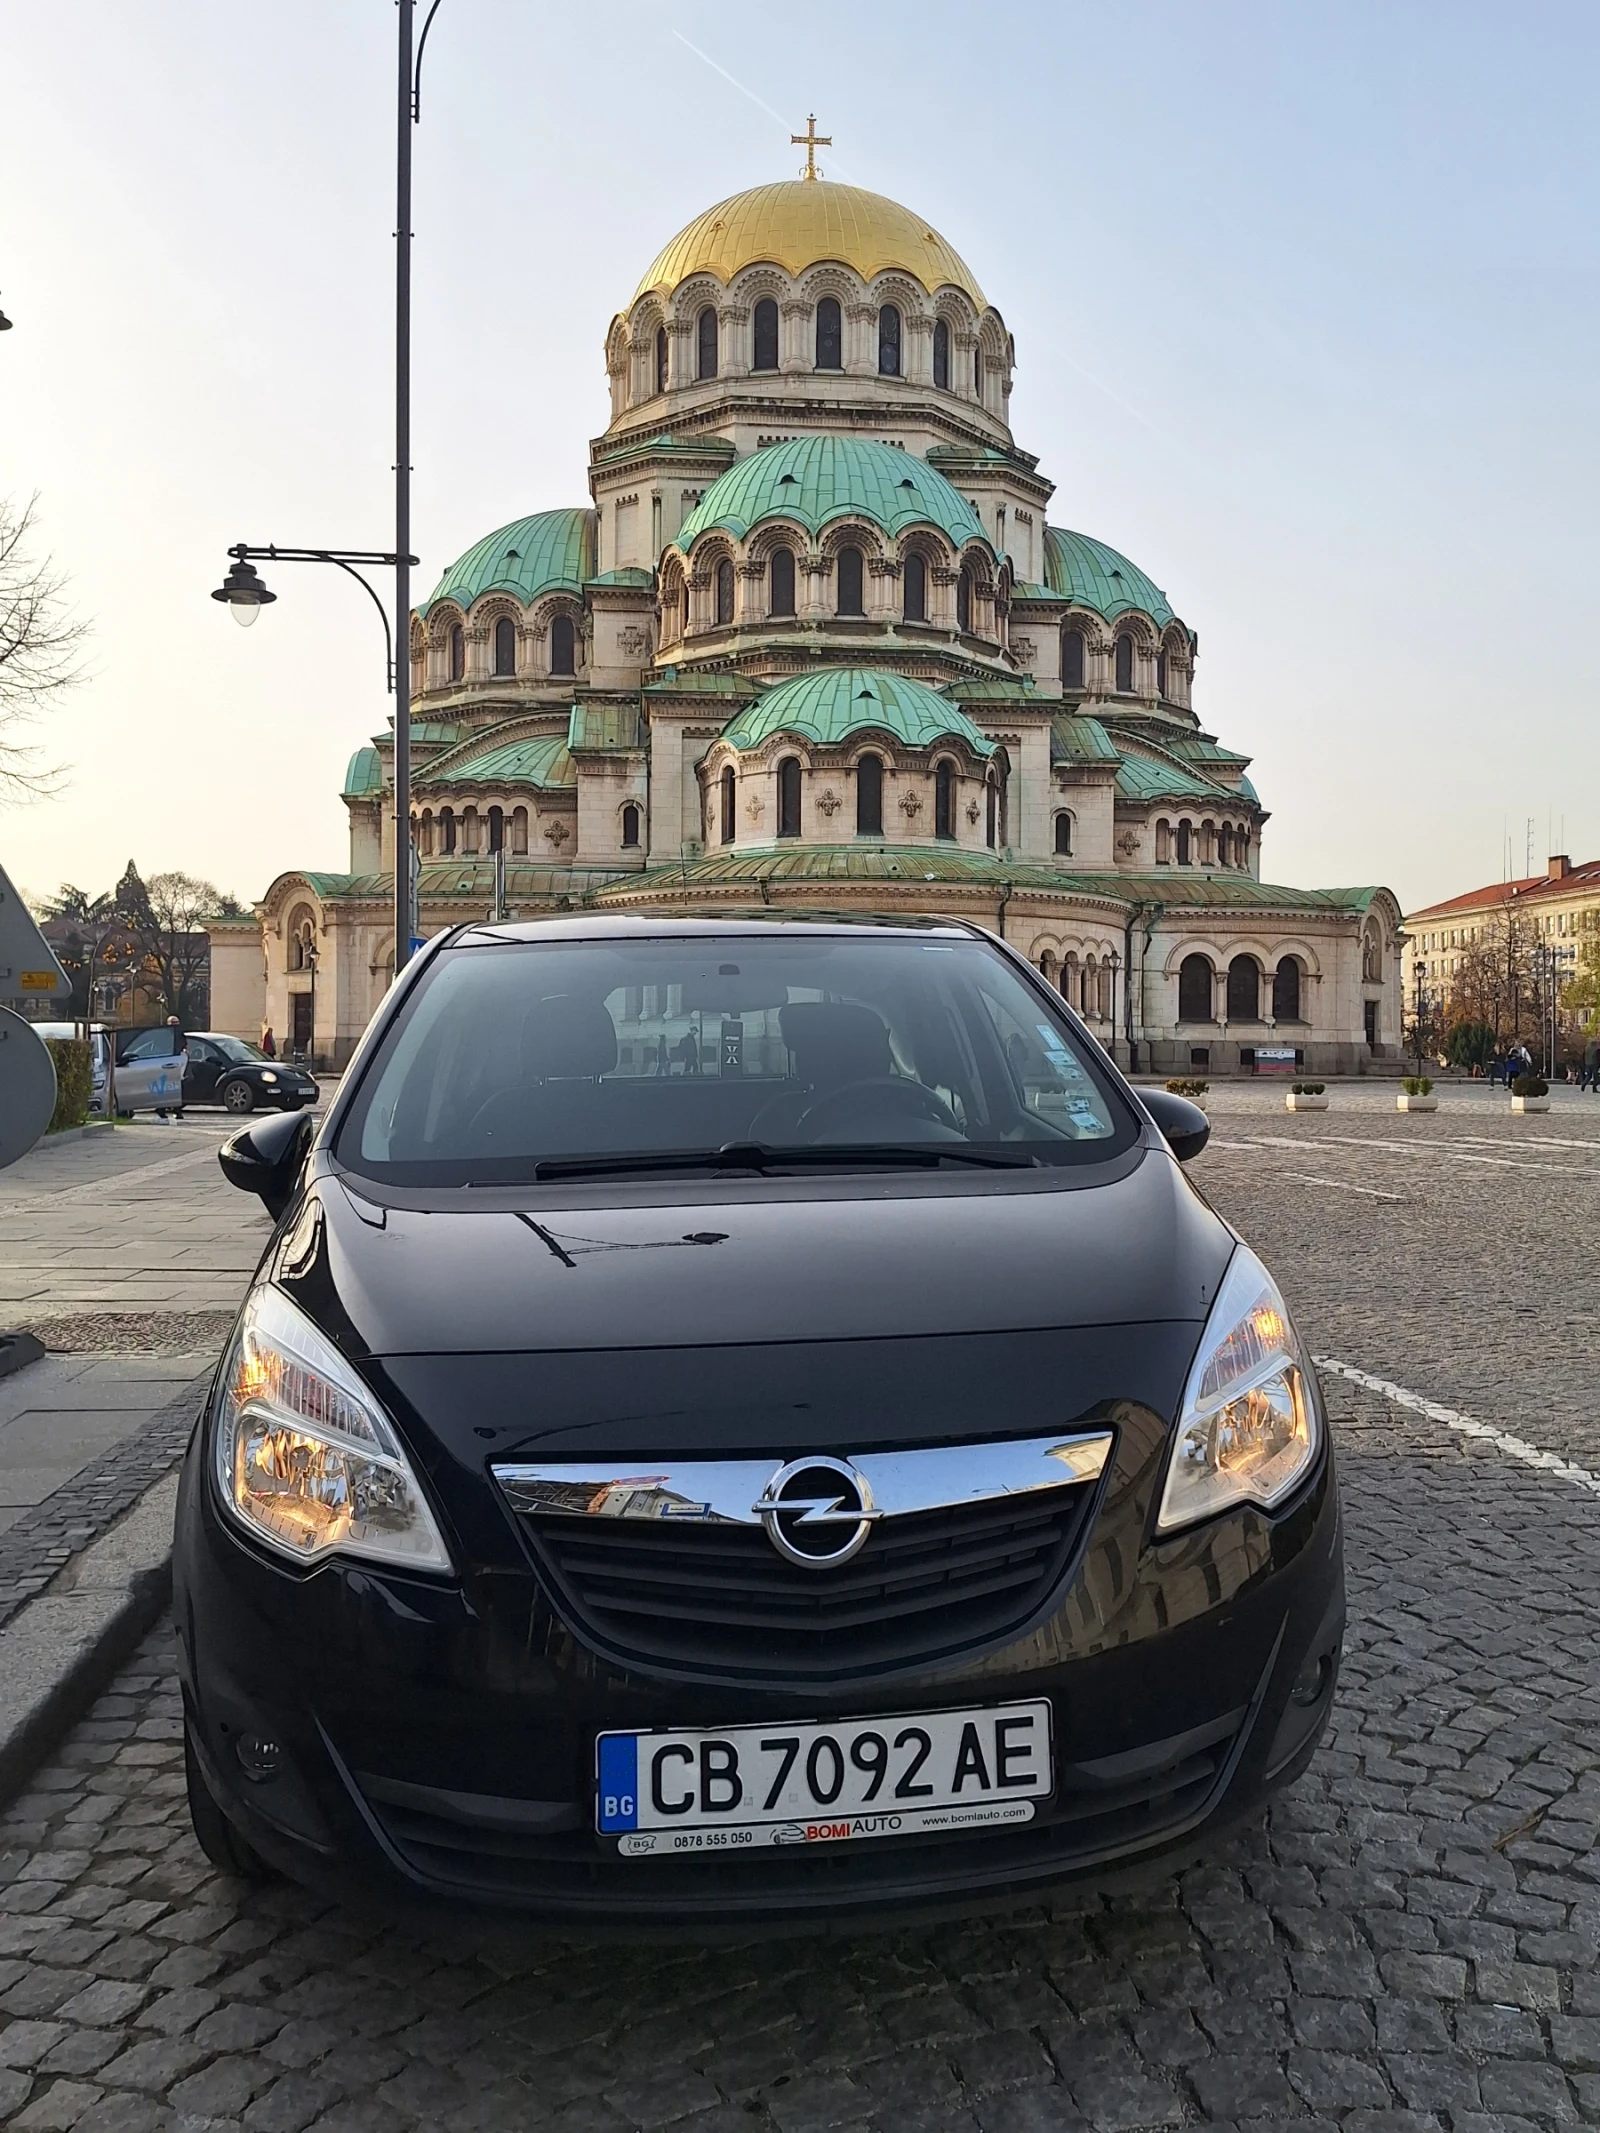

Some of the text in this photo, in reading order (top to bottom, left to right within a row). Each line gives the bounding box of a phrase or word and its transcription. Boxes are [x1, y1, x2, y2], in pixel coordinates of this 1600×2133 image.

[651, 1716, 1038, 1815] CB 7092 AE
[604, 1796, 634, 1818] BG
[922, 1808, 1026, 1826] www.bomiauto.com
[633, 1840, 650, 1849] BG
[674, 1831, 753, 1848] 0878 555 050
